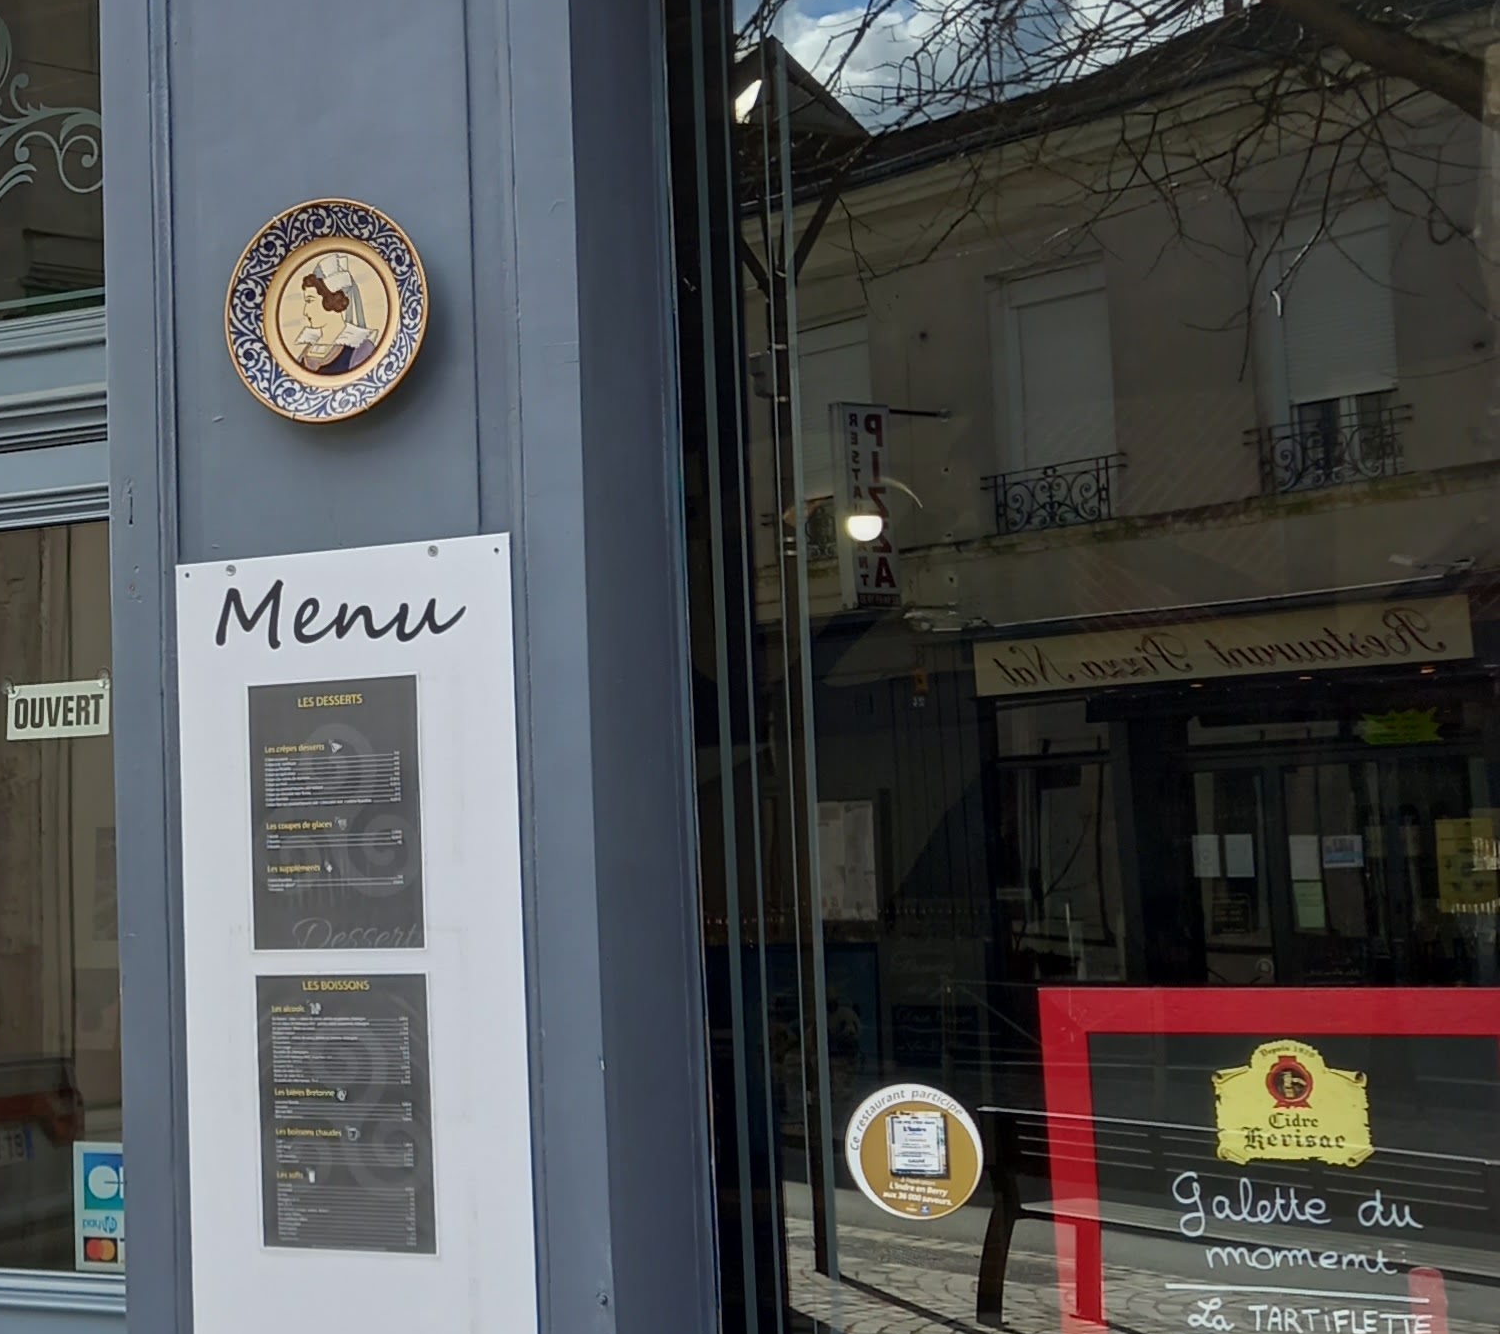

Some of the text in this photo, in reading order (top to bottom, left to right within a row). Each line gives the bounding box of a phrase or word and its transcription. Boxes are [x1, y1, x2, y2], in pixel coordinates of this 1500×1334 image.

[214, 578, 467, 650] Menu
[14, 693, 105, 730] OUVERT
[297, 693, 363, 708] LES DESSERTS
[302, 979, 370, 992] LES BOISSONS
[849, 1089, 964, 1152] Ce restaurant participe
[1268, 1112, 1319, 1130] Cidre
[1241, 1127, 1346, 1151] Kerisac
[926, 1186, 949, 1198] Berry
[1171, 1170, 1424, 1238] Galette du
[1186, 1296, 1236, 1332] La
